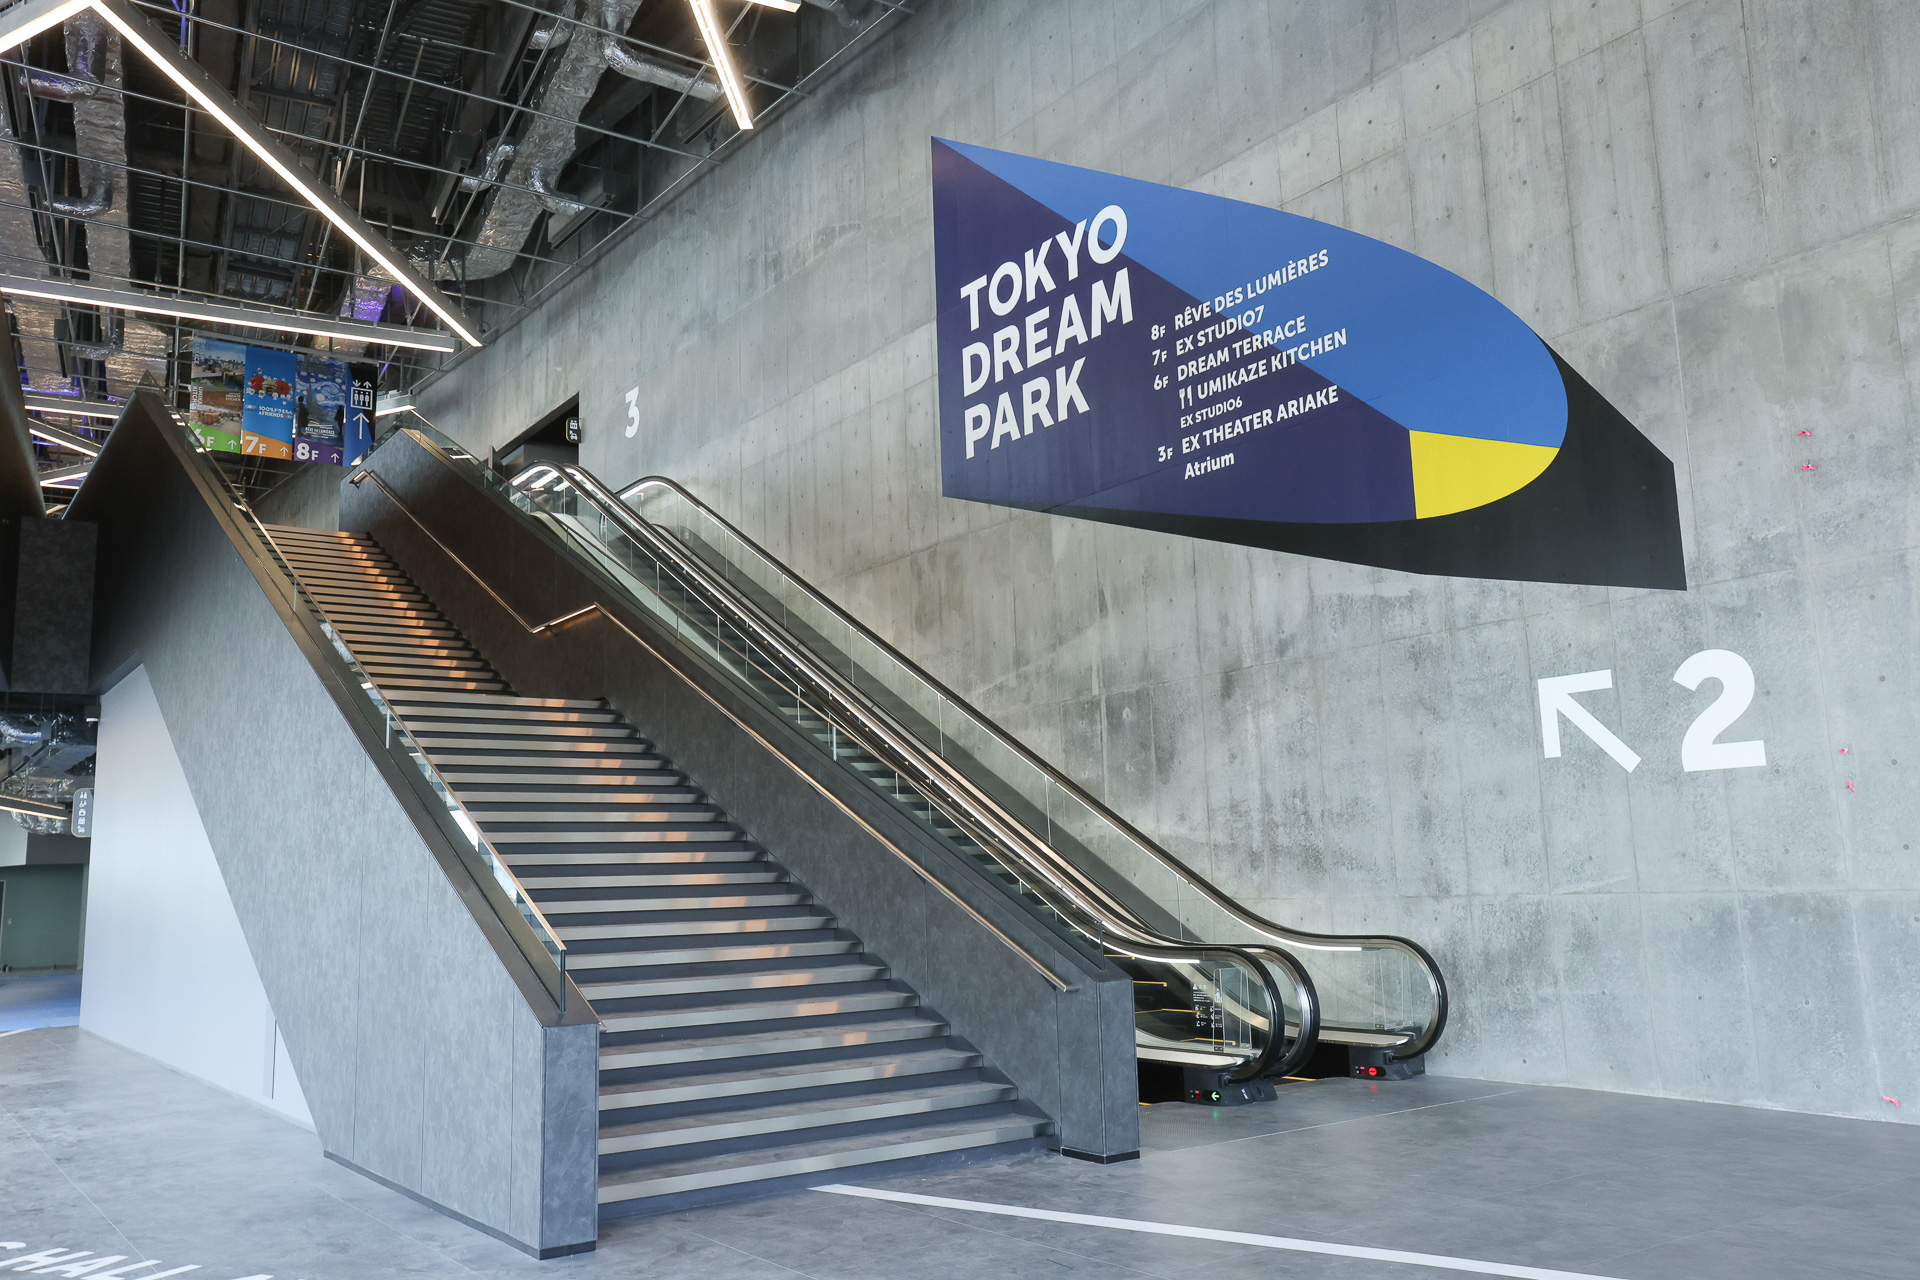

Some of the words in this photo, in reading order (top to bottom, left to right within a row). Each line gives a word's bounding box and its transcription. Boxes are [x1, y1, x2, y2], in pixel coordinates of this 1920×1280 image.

[960, 205, 1128, 332] TOKYO
[1150, 324, 1166, 341] 8F
[1174, 301, 1212, 331] RÊVE
[1214, 287, 1244, 314] DES
[1246, 249, 1329, 300] LUMIÈRES
[962, 267, 1134, 398] DREAM
[1152, 348, 1168, 366] 7F
[1175, 334, 1195, 356] EX
[1196, 305, 1265, 347] STUDIO7
[1153, 374, 1169, 391] 6F
[1177, 346, 1230, 382] DREAM
[1231, 315, 1307, 359] TERRACE
[1197, 358, 1268, 400] UMIKAZE
[1271, 328, 1347, 373] KITCHEN
[245, 435, 267, 454] 7F
[624, 386, 640, 439] 3
[964, 356, 1090, 460] PARK
[1157, 445, 1173, 462] 3F
[1181, 433, 1201, 455] EX
[1202, 408, 1274, 446] THEATER
[1276, 385, 1339, 423] ARIAKE
[1180, 413, 1194, 429] EX
[1195, 396, 1243, 423] STUDIO6
[296, 442, 319, 461] 8F
[1184, 452, 1235, 480] Atrium
[1672, 648, 1767, 772] 2
